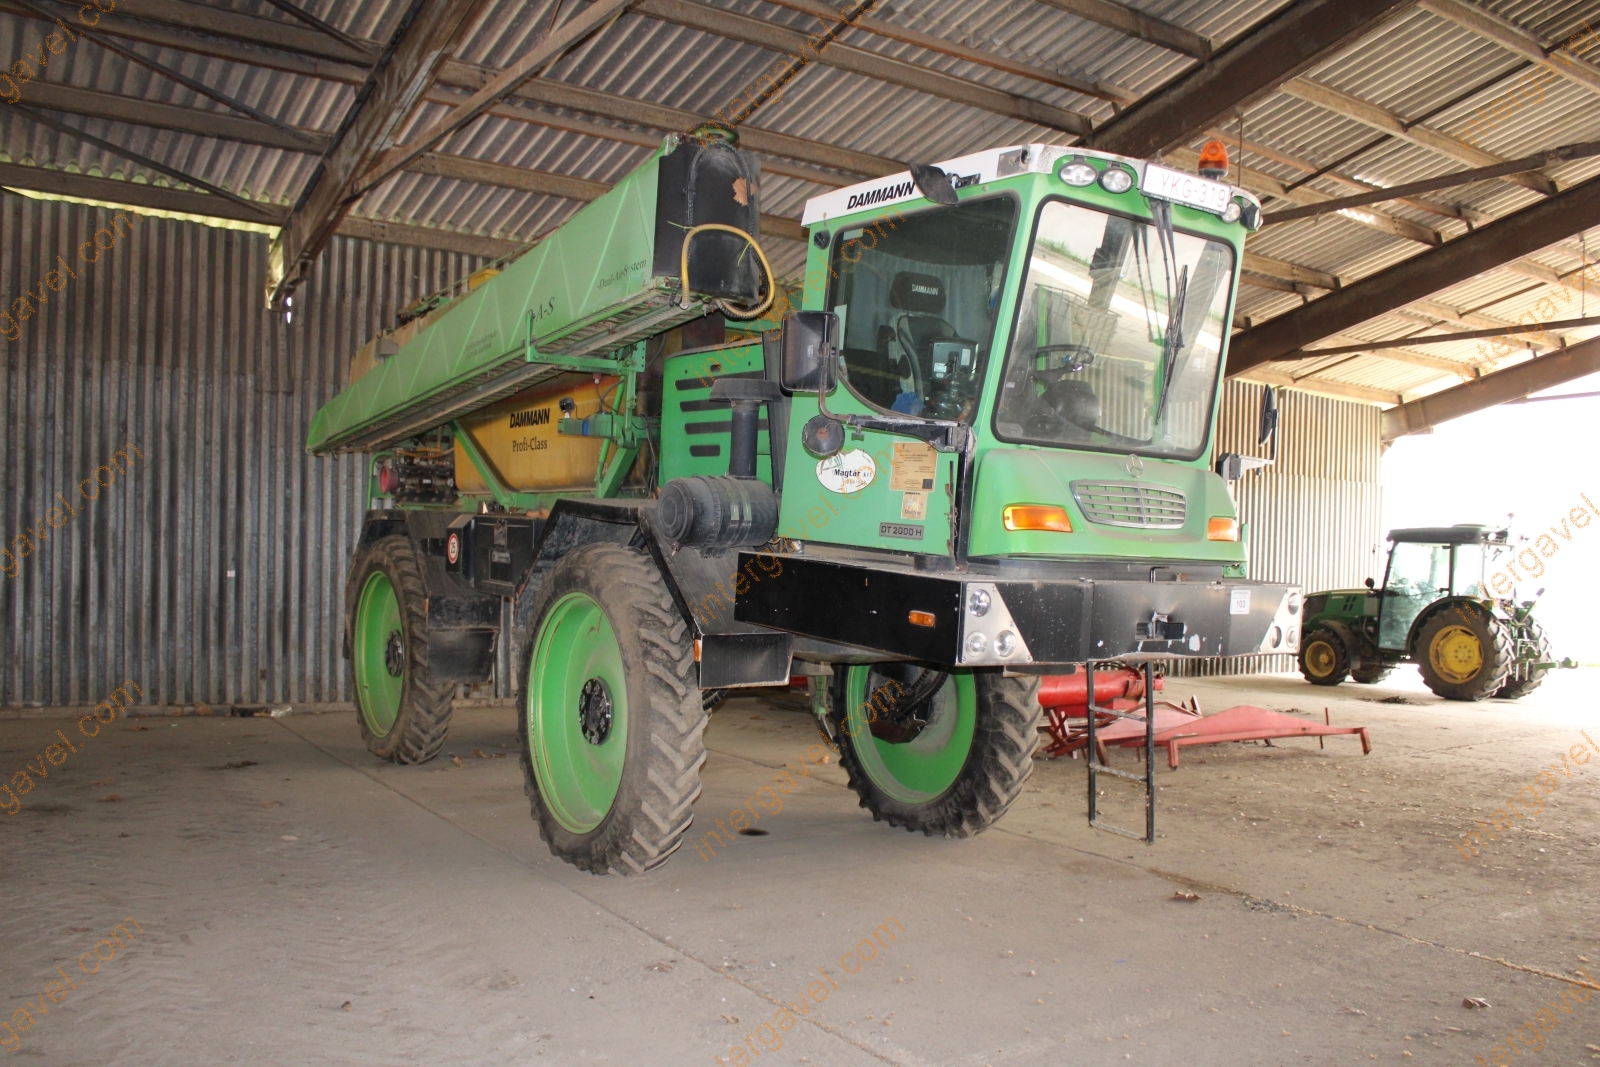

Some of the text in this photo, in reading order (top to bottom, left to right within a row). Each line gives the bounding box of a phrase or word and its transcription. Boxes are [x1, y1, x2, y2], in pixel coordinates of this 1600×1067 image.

[847, 181, 916, 210] DAMMANN
[510, 408, 550, 428] DAMMANN
[512, 436, 548, 452] Profi-Class
[880, 525, 922, 537] DT 2000 H
